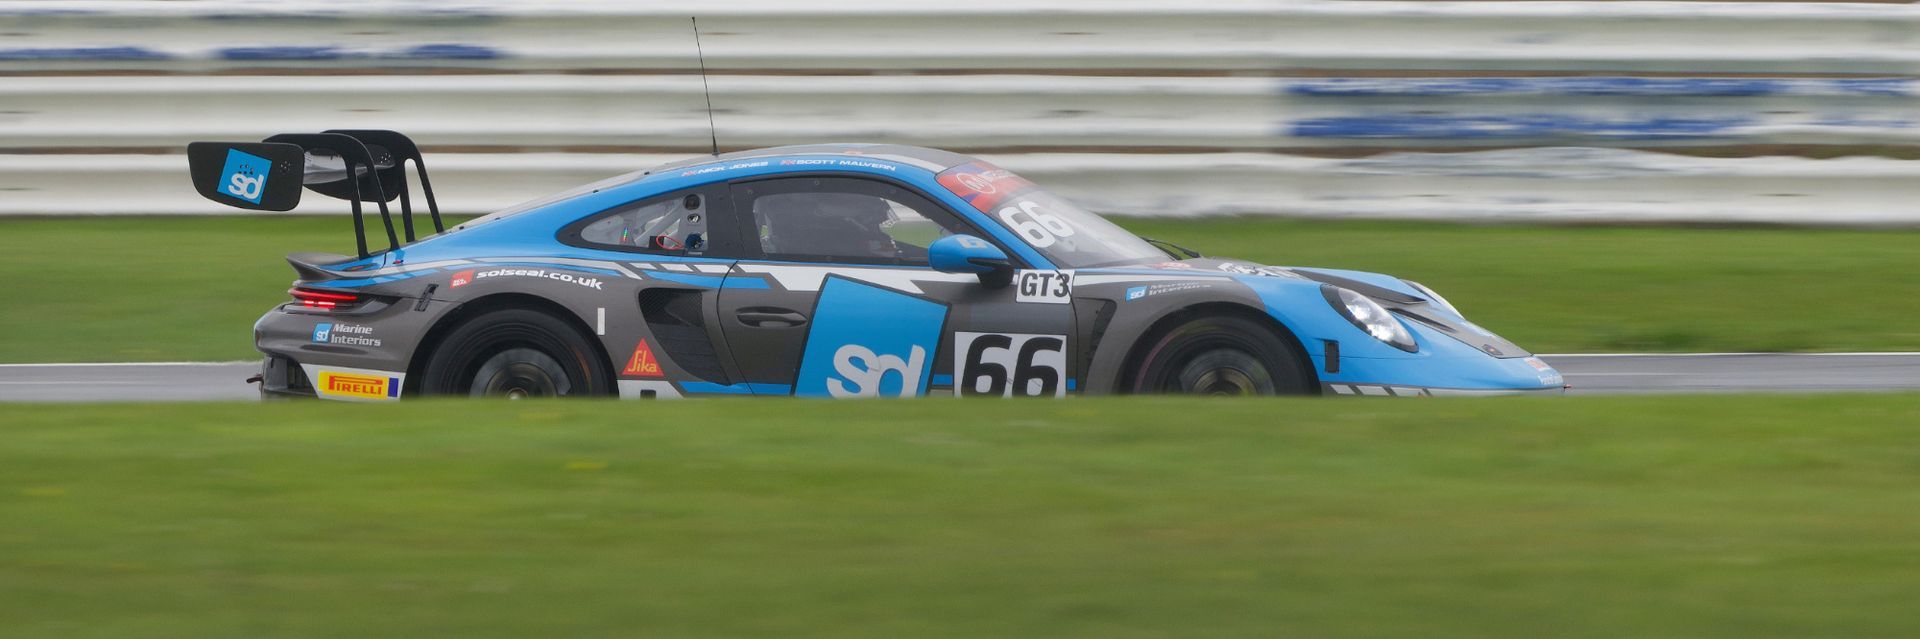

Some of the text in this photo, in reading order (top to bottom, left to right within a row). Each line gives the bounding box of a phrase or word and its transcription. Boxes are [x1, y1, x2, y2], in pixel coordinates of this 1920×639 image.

[697, 161, 769, 174] NICK JONES
[839, 160, 897, 171] MALVERN
[228, 173, 265, 199] sd
[999, 201, 1075, 248] 66
[476, 269, 604, 290] solseal.co.uk
[1020, 272, 1070, 298] GT3
[316, 329, 329, 341] sd
[330, 333, 382, 347] Interiors
[332, 324, 373, 335] Marine
[627, 350, 657, 373] Sika
[826, 344, 926, 398] sd
[961, 334, 1064, 398] 66
[328, 375, 384, 395] PIRELLI
